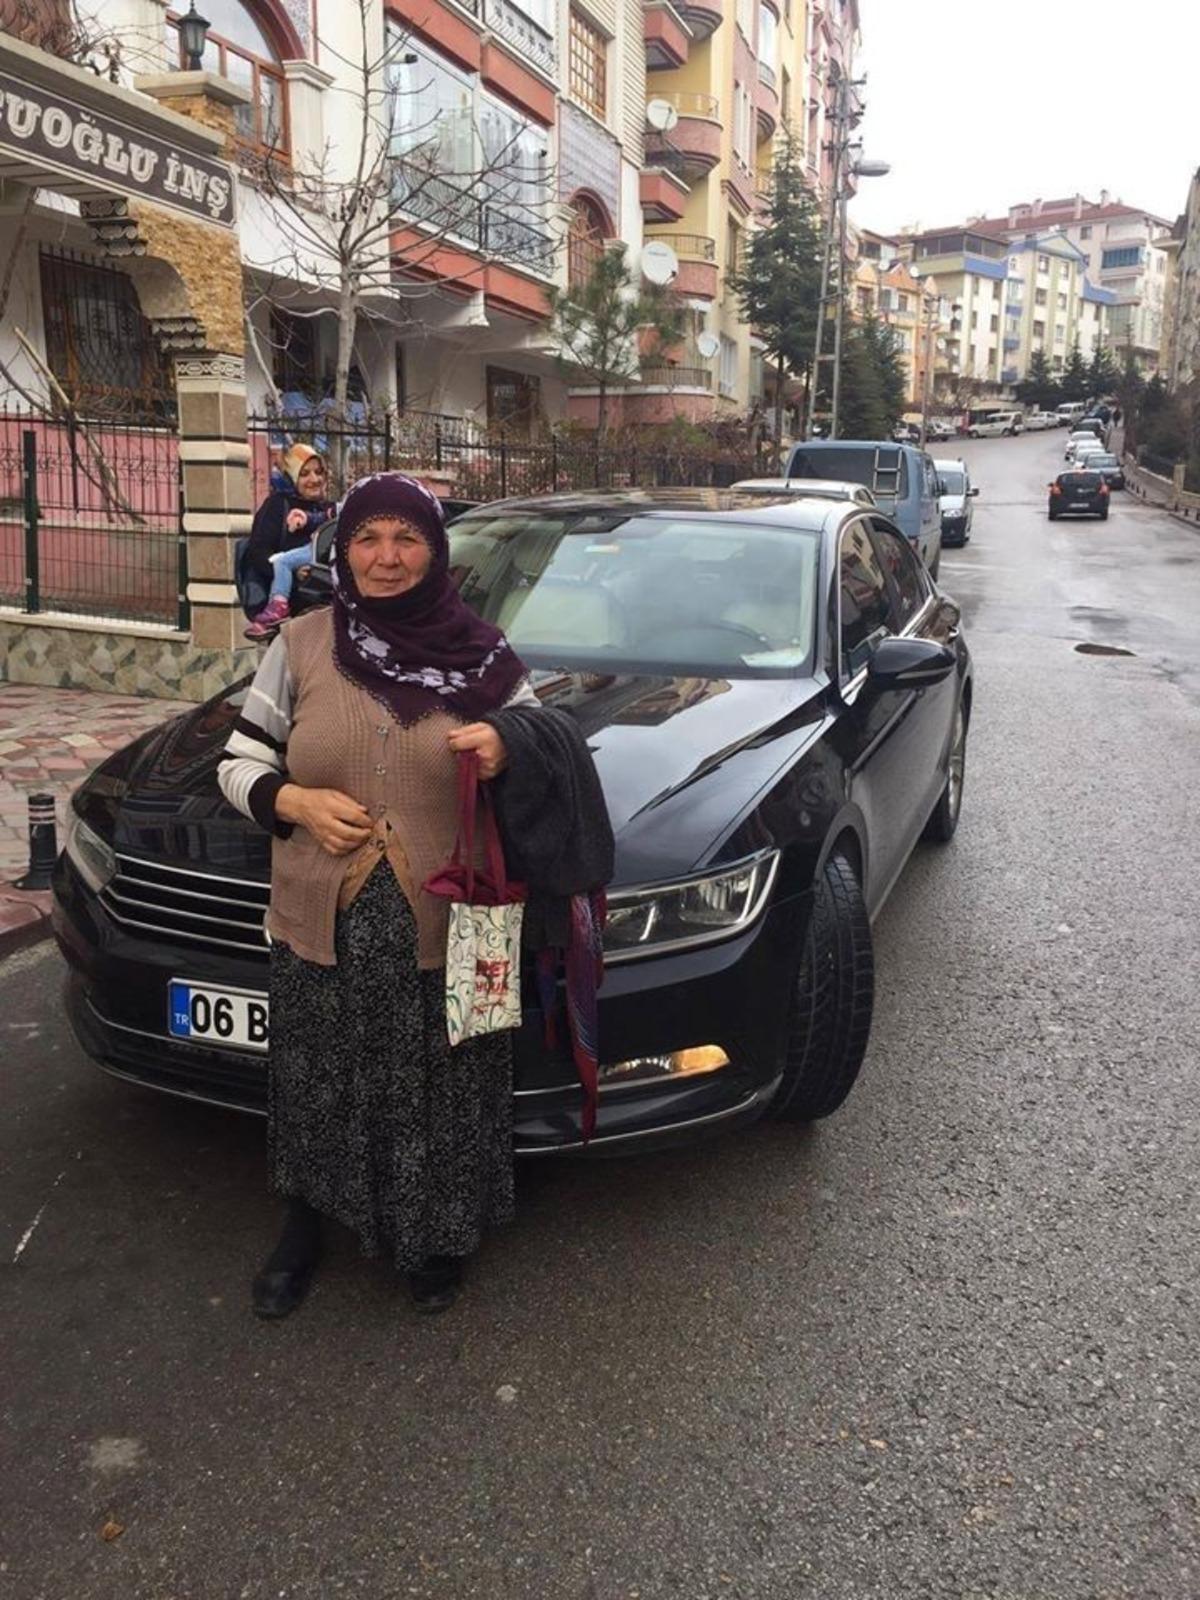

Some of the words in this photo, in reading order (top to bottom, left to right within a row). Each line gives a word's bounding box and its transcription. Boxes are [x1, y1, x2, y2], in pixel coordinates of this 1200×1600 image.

[0, 89, 158, 183] UOĞLU
[163, 152, 230, 218] İNŞ
[174, 1012, 190, 1026] TR
[190, 993, 234, 1038] 06
[247, 1001, 269, 1043] B
